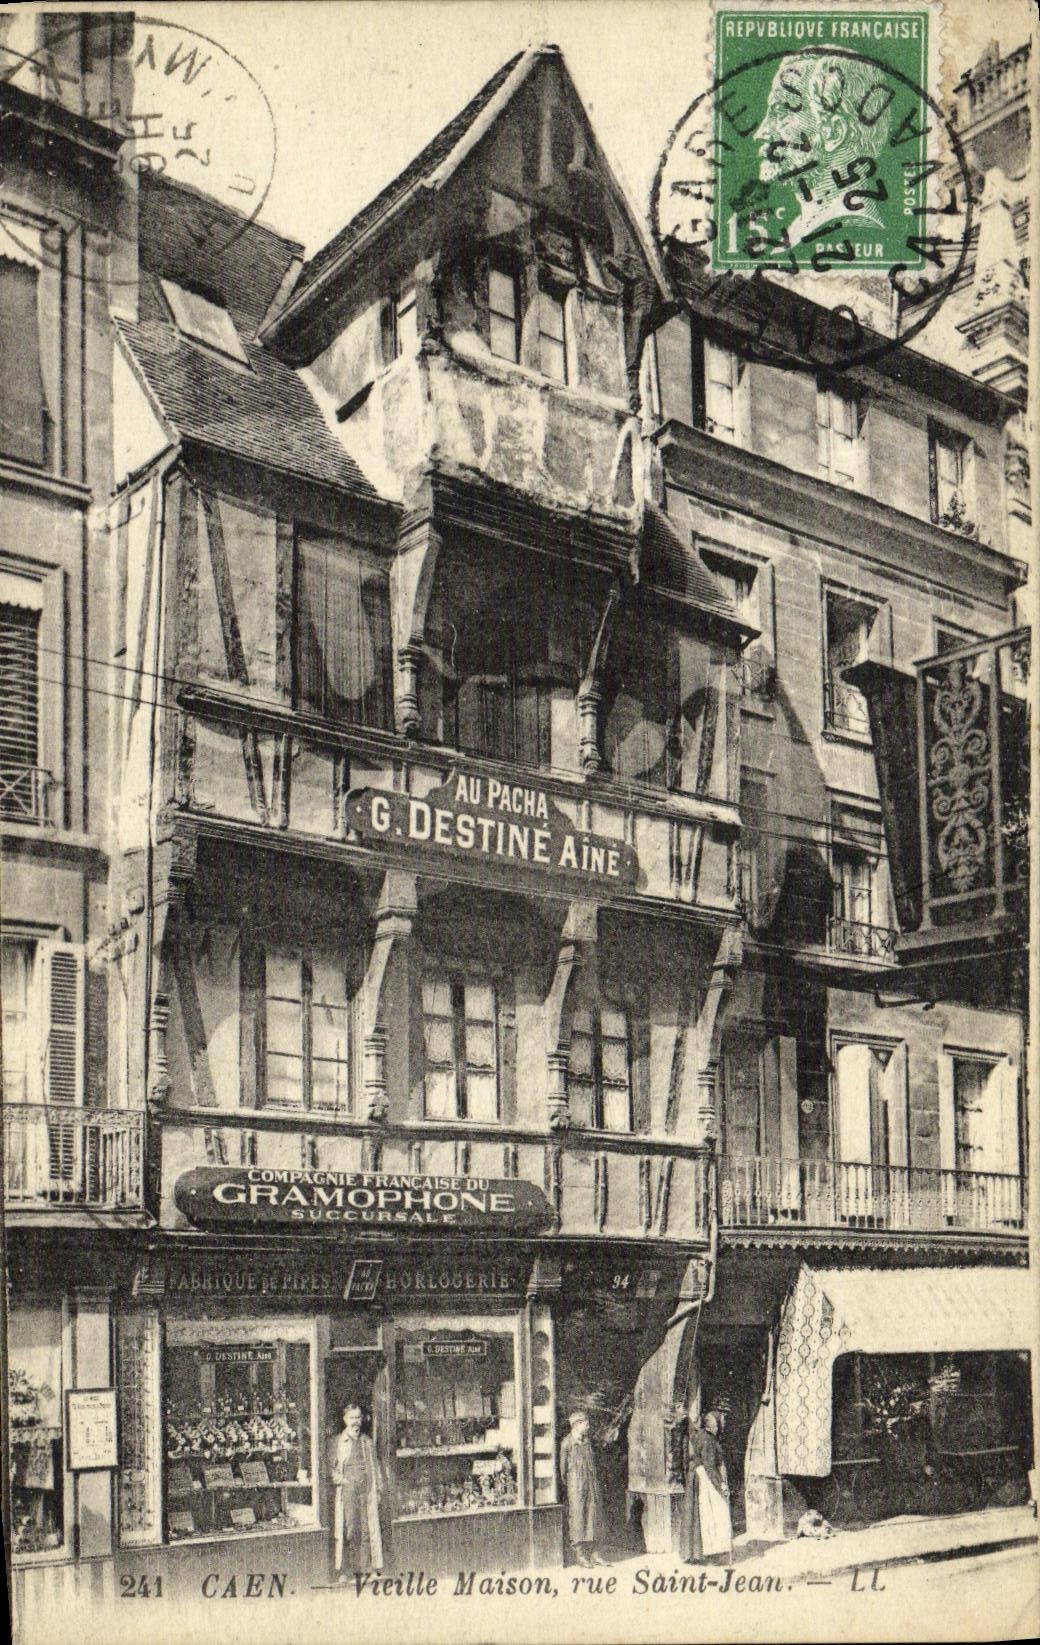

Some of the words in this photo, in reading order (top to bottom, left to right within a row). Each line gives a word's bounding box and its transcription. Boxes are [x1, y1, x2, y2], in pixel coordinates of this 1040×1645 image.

[455, 774, 481, 805] AU
[488, 778, 549, 820] PACHA
[371, 796, 402, 836] G.
[408, 801, 551, 864] DESTINÉ
[247, 1169, 356, 1186] COMPAGNIE
[362, 1174, 461, 1191] FRANÇAISE
[466, 1179, 490, 1191] DU
[212, 1183, 516, 1213] GRAMOPHONE
[291, 1209, 457, 1223] SUCCURSALE
[612, 1274, 630, 1289] 94
